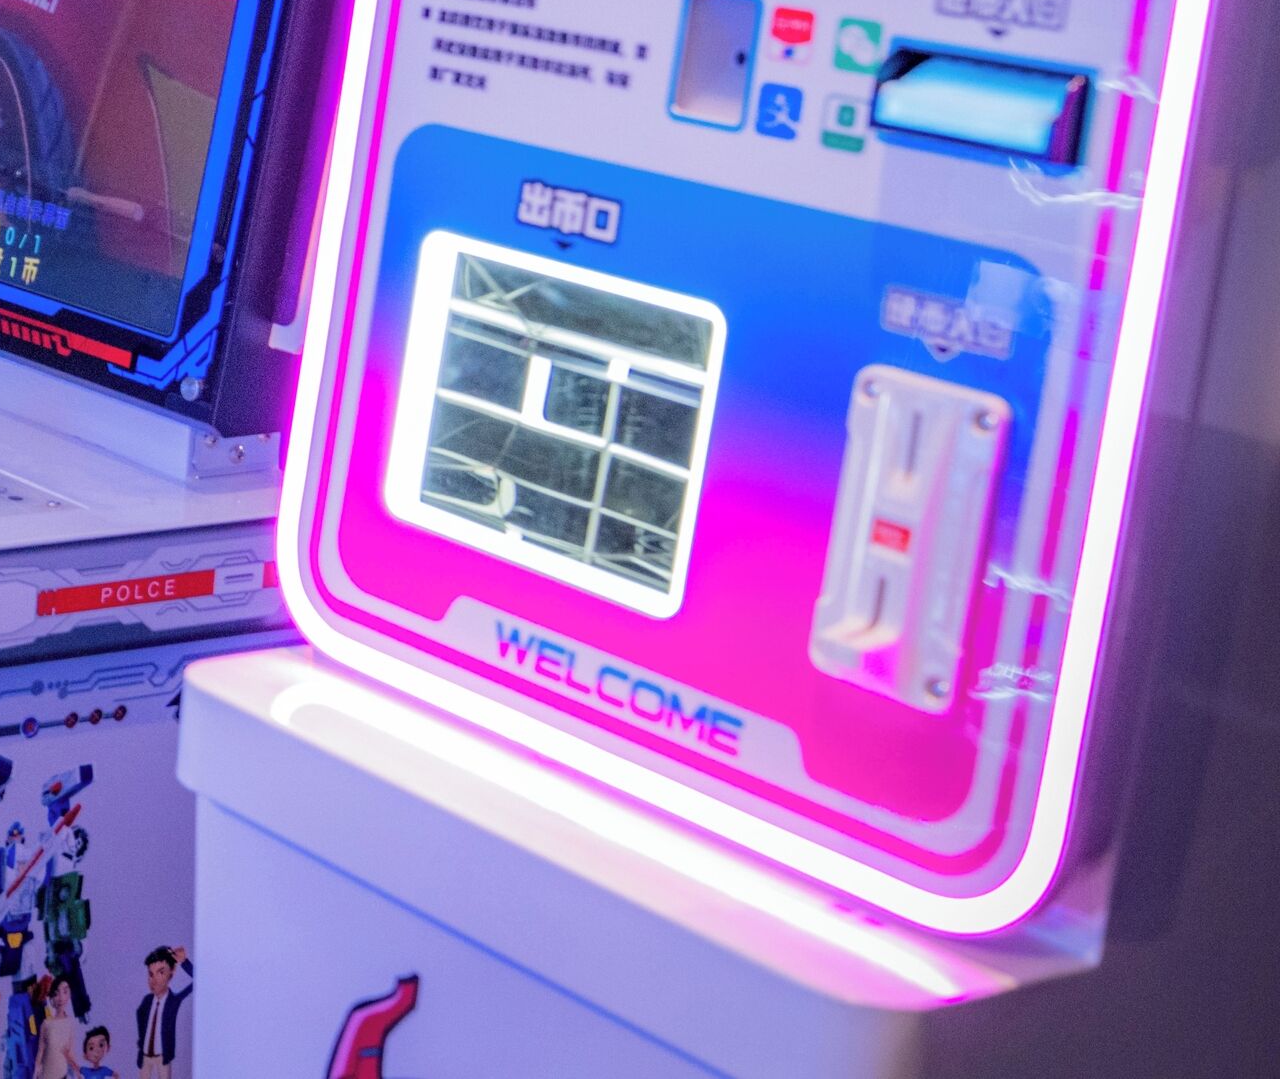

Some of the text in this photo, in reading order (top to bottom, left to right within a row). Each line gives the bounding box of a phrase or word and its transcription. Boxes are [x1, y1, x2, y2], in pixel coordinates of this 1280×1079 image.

[517, 179, 621, 244] 出币口
[100, 578, 176, 604] POLCE
[495, 619, 744, 757] WELCOME
